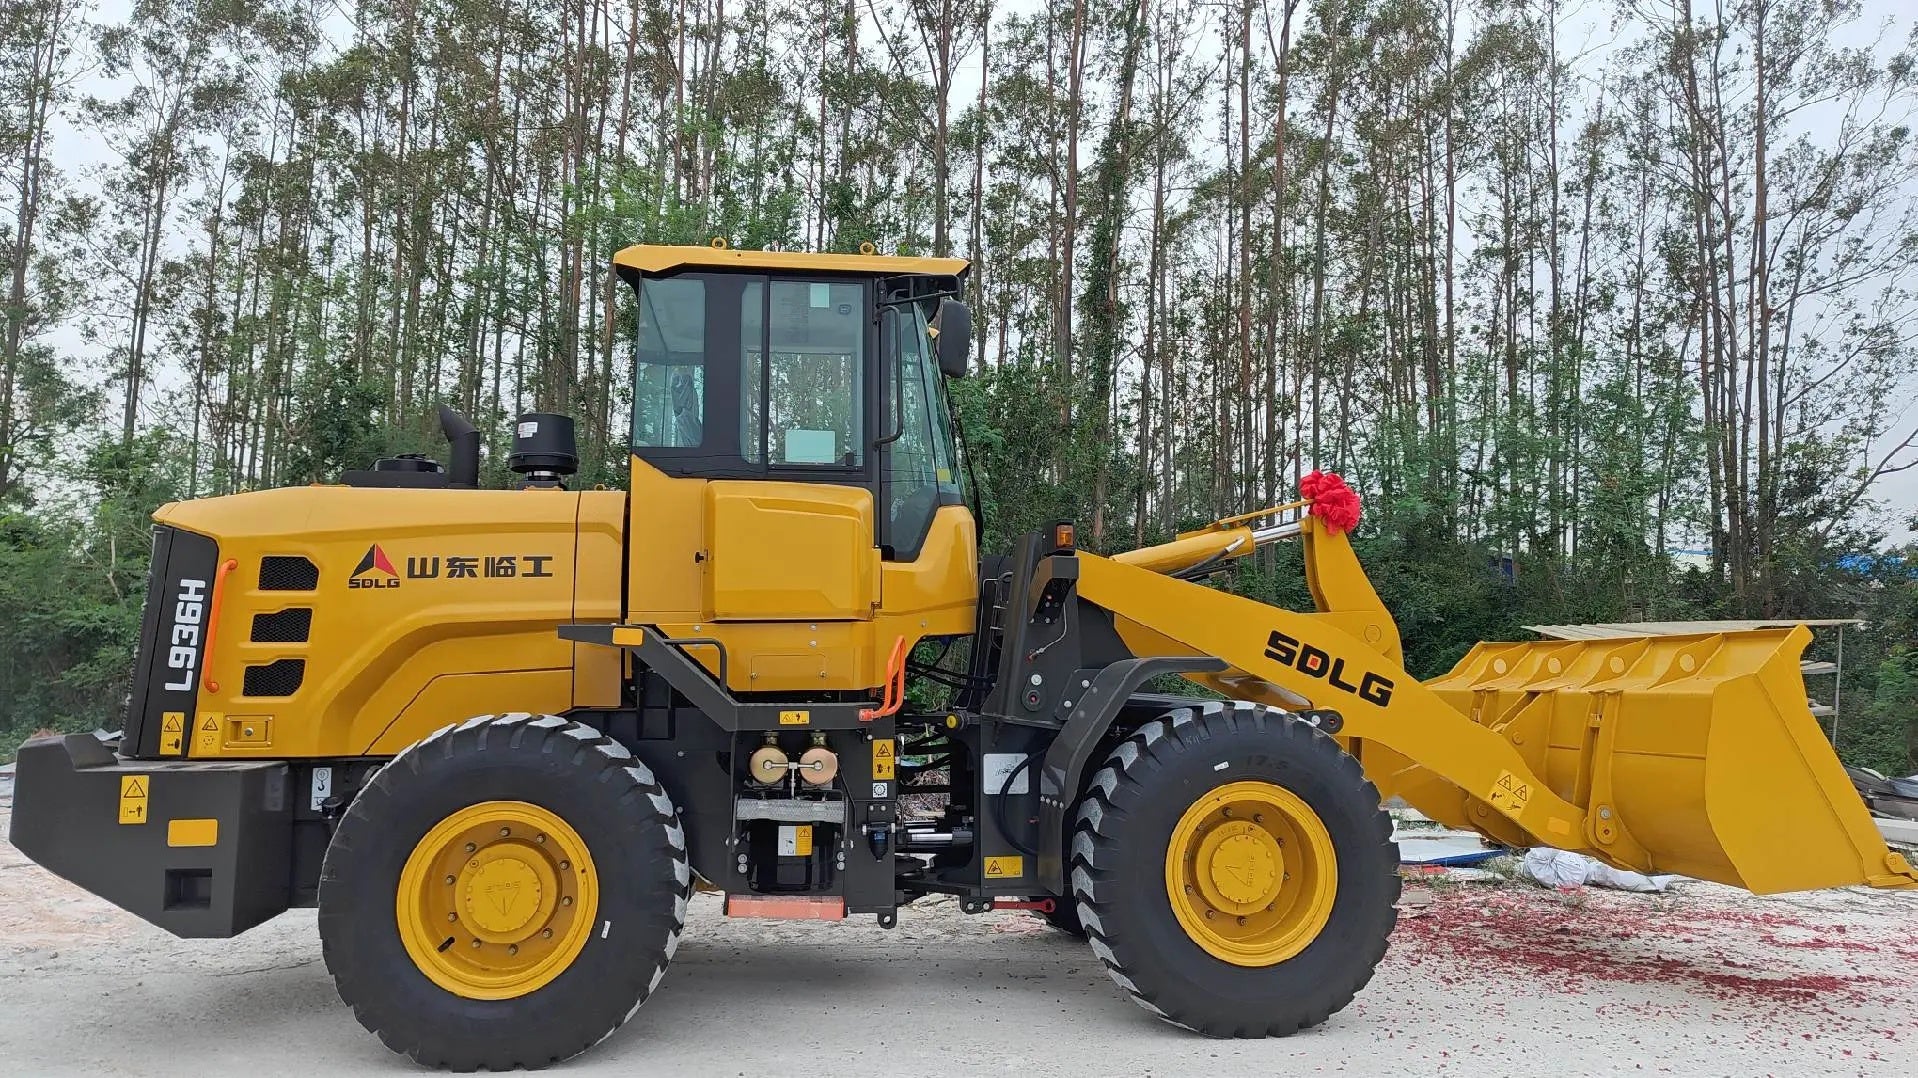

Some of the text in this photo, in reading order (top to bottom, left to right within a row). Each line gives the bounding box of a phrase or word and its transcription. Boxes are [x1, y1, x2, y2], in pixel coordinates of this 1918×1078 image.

[348, 578, 400, 589] SDLG
[407, 556, 553, 579] 山东临工
[164, 579, 206, 691] L936H
[1264, 630, 1394, 707] SDLG
